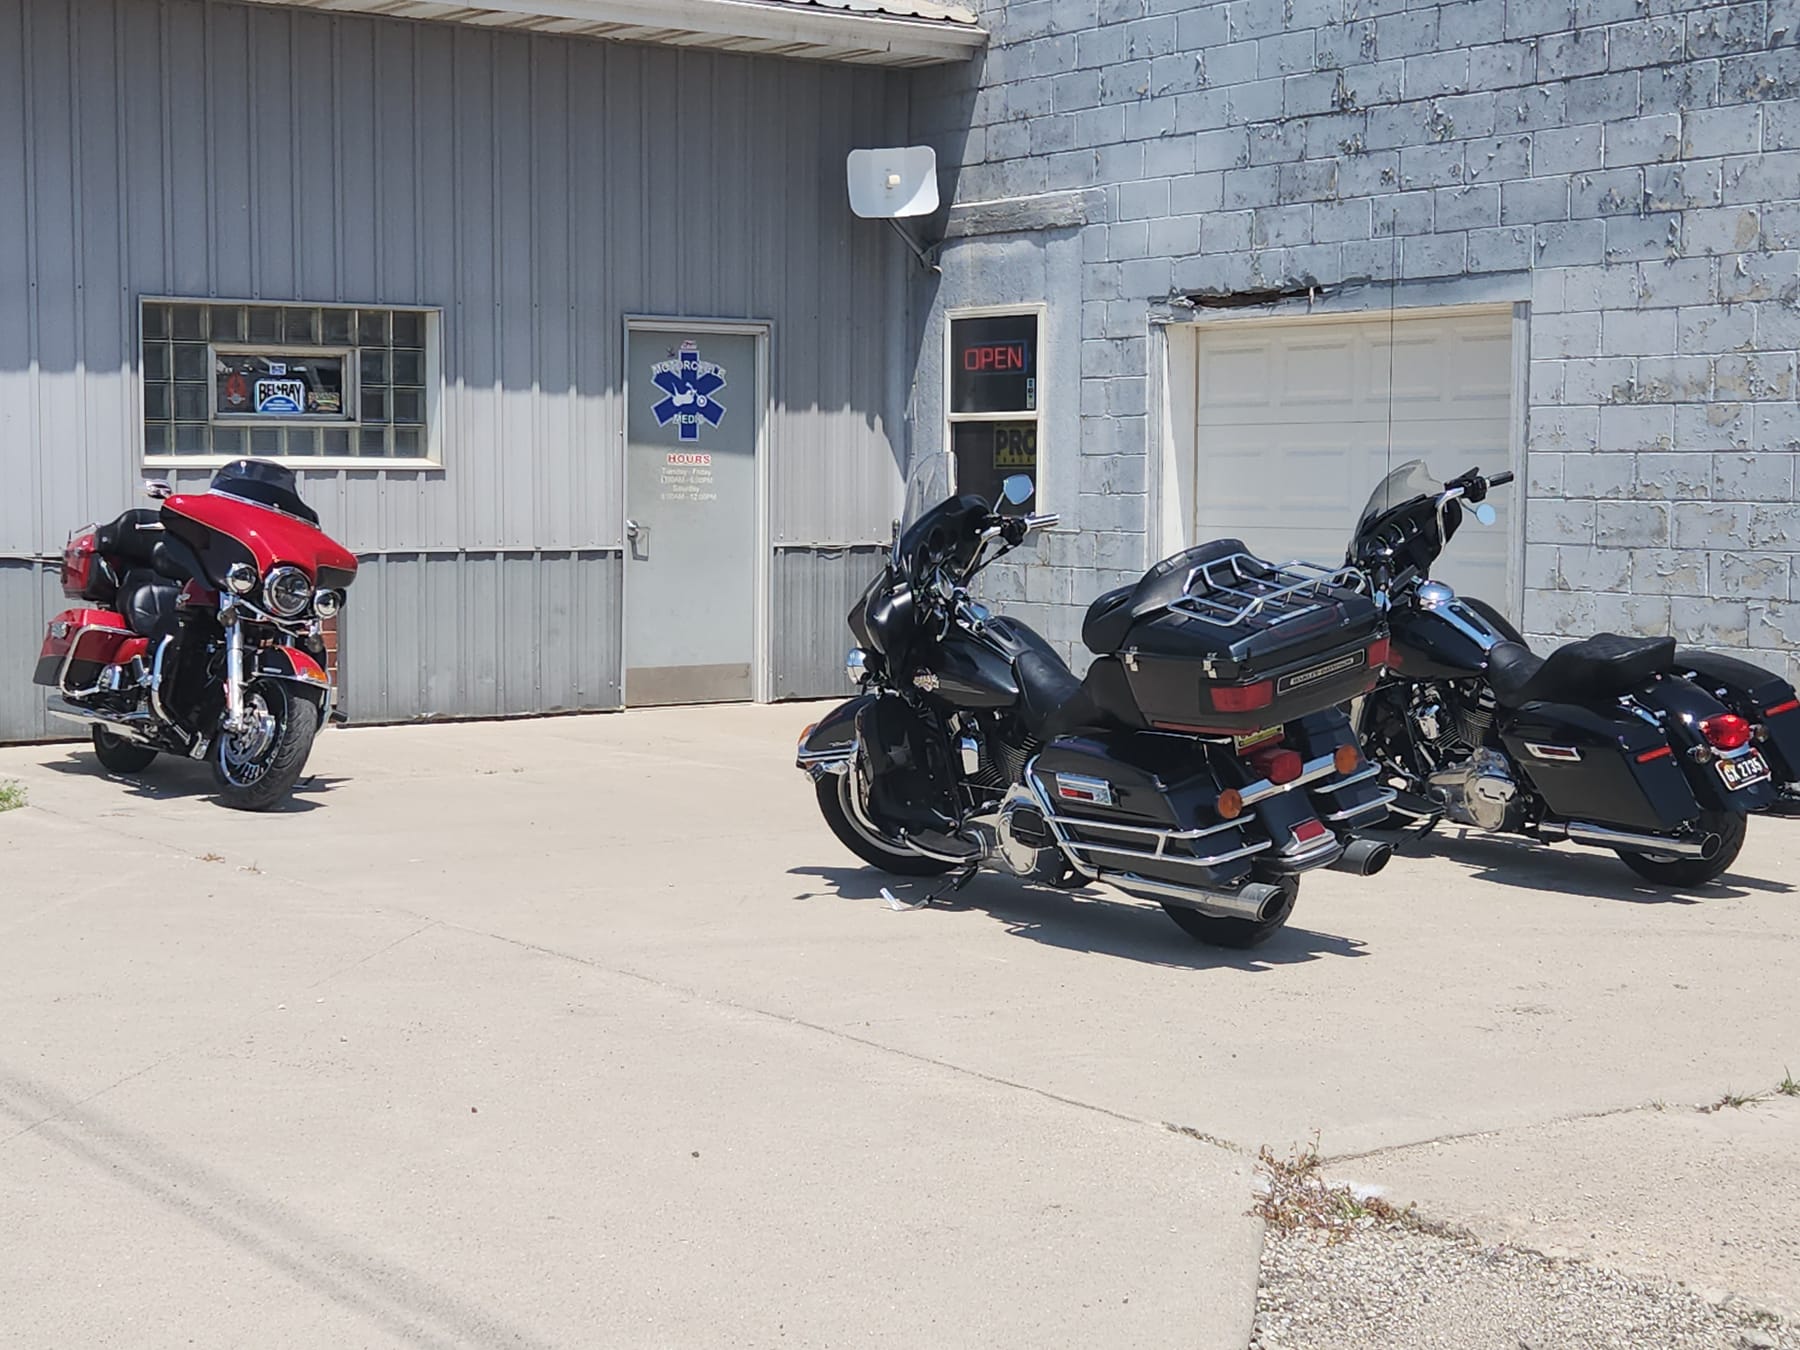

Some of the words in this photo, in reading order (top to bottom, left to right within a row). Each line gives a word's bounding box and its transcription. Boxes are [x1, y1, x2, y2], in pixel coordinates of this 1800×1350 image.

[964, 347, 1022, 370] OPEN
[651, 359, 727, 378] MOTORCYCLE
[673, 413, 705, 424] MEDIC
[667, 453, 711, 465] HOURS
[1292, 658, 1352, 684] HARLEY-DAVIDSON
